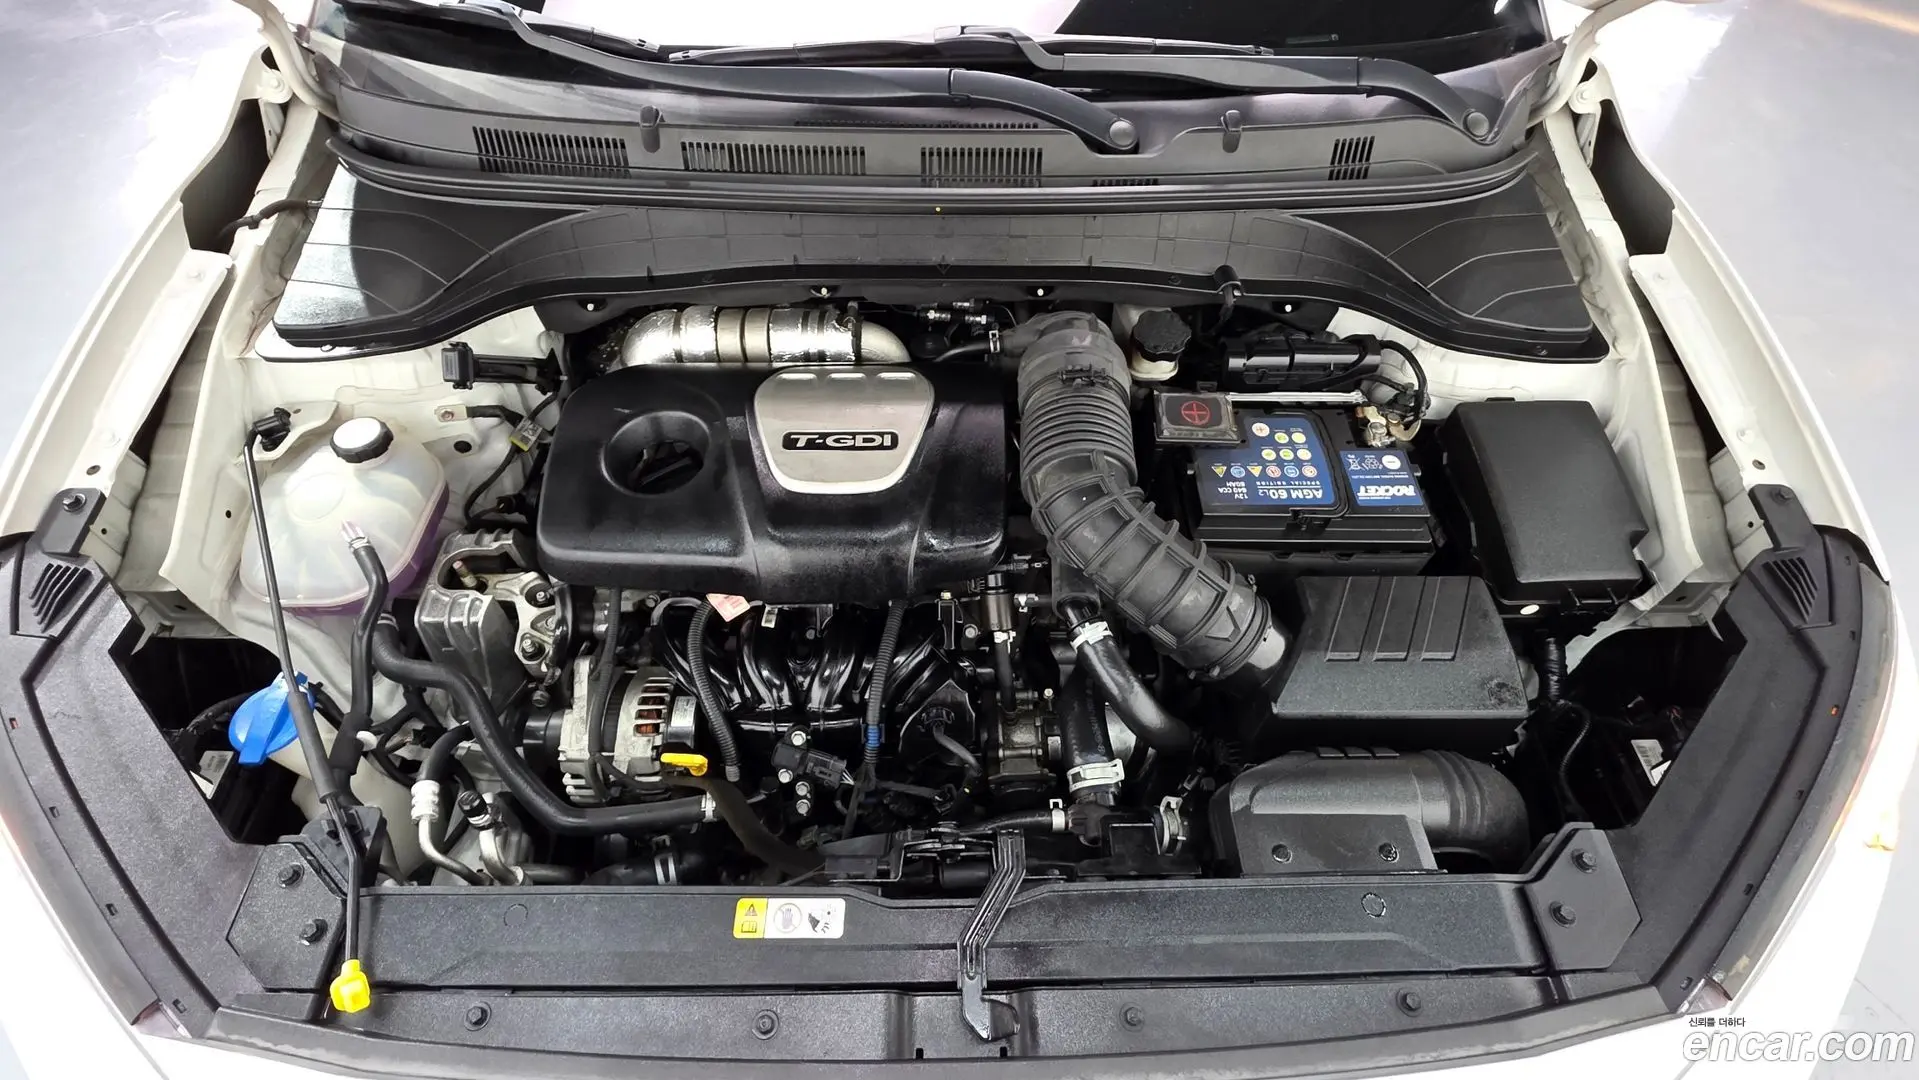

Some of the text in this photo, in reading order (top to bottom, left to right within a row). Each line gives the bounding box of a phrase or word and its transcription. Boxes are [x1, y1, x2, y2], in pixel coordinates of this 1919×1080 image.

[790, 434, 892, 447] T-GDI
[1290, 489, 1323, 499] AGM
[1357, 485, 1416, 496] ROCKET
